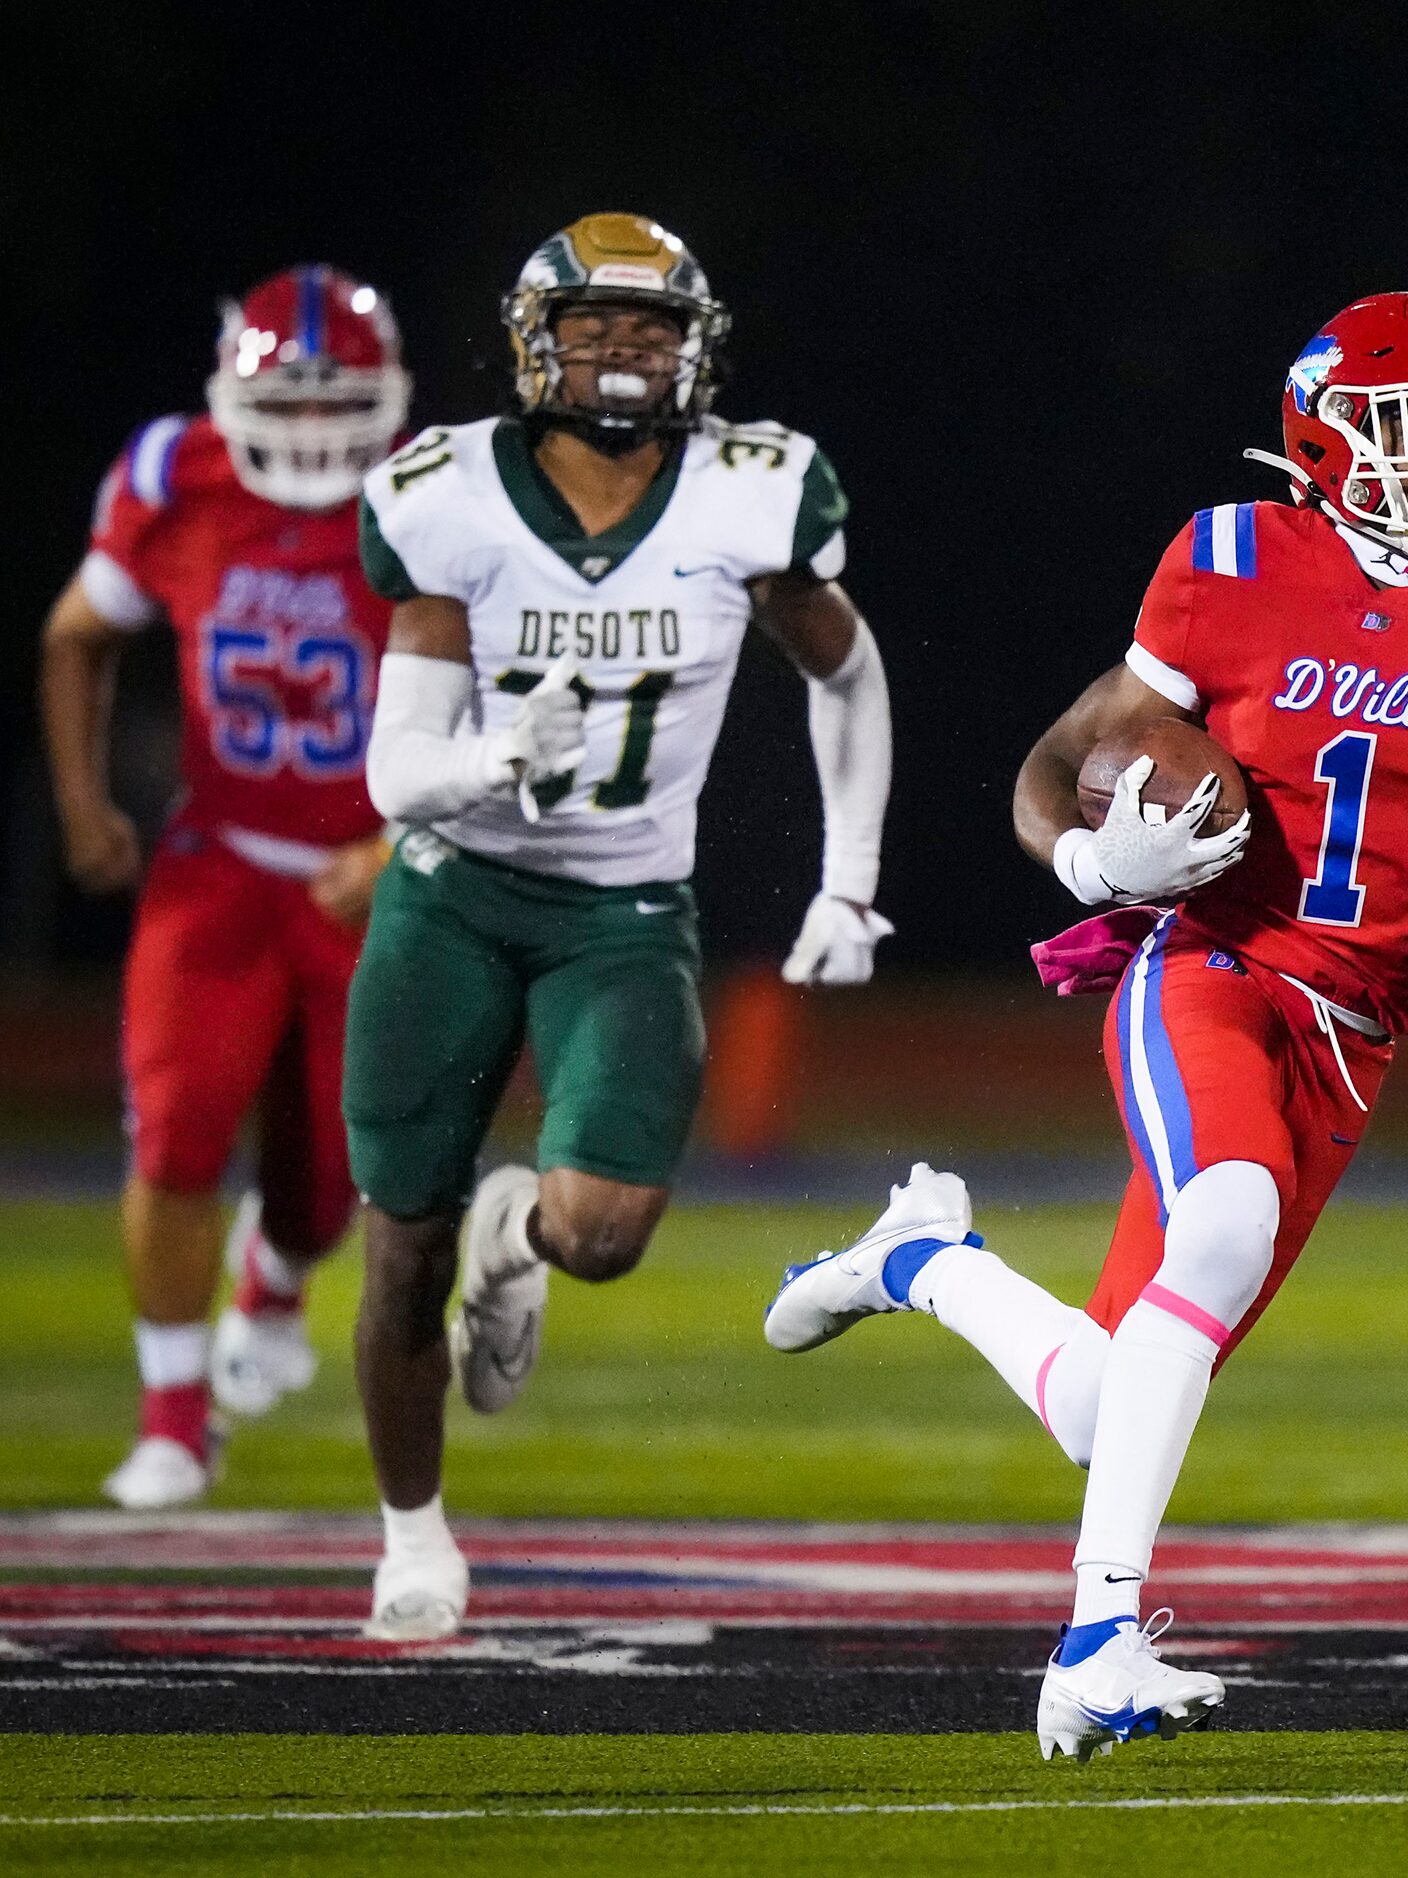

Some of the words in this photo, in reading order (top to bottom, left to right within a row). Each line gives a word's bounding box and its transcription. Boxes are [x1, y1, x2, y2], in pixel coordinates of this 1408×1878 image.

[199, 616, 376, 780] 53
[517, 608, 681, 659] DESOTO
[1297, 729, 1378, 928] 1
